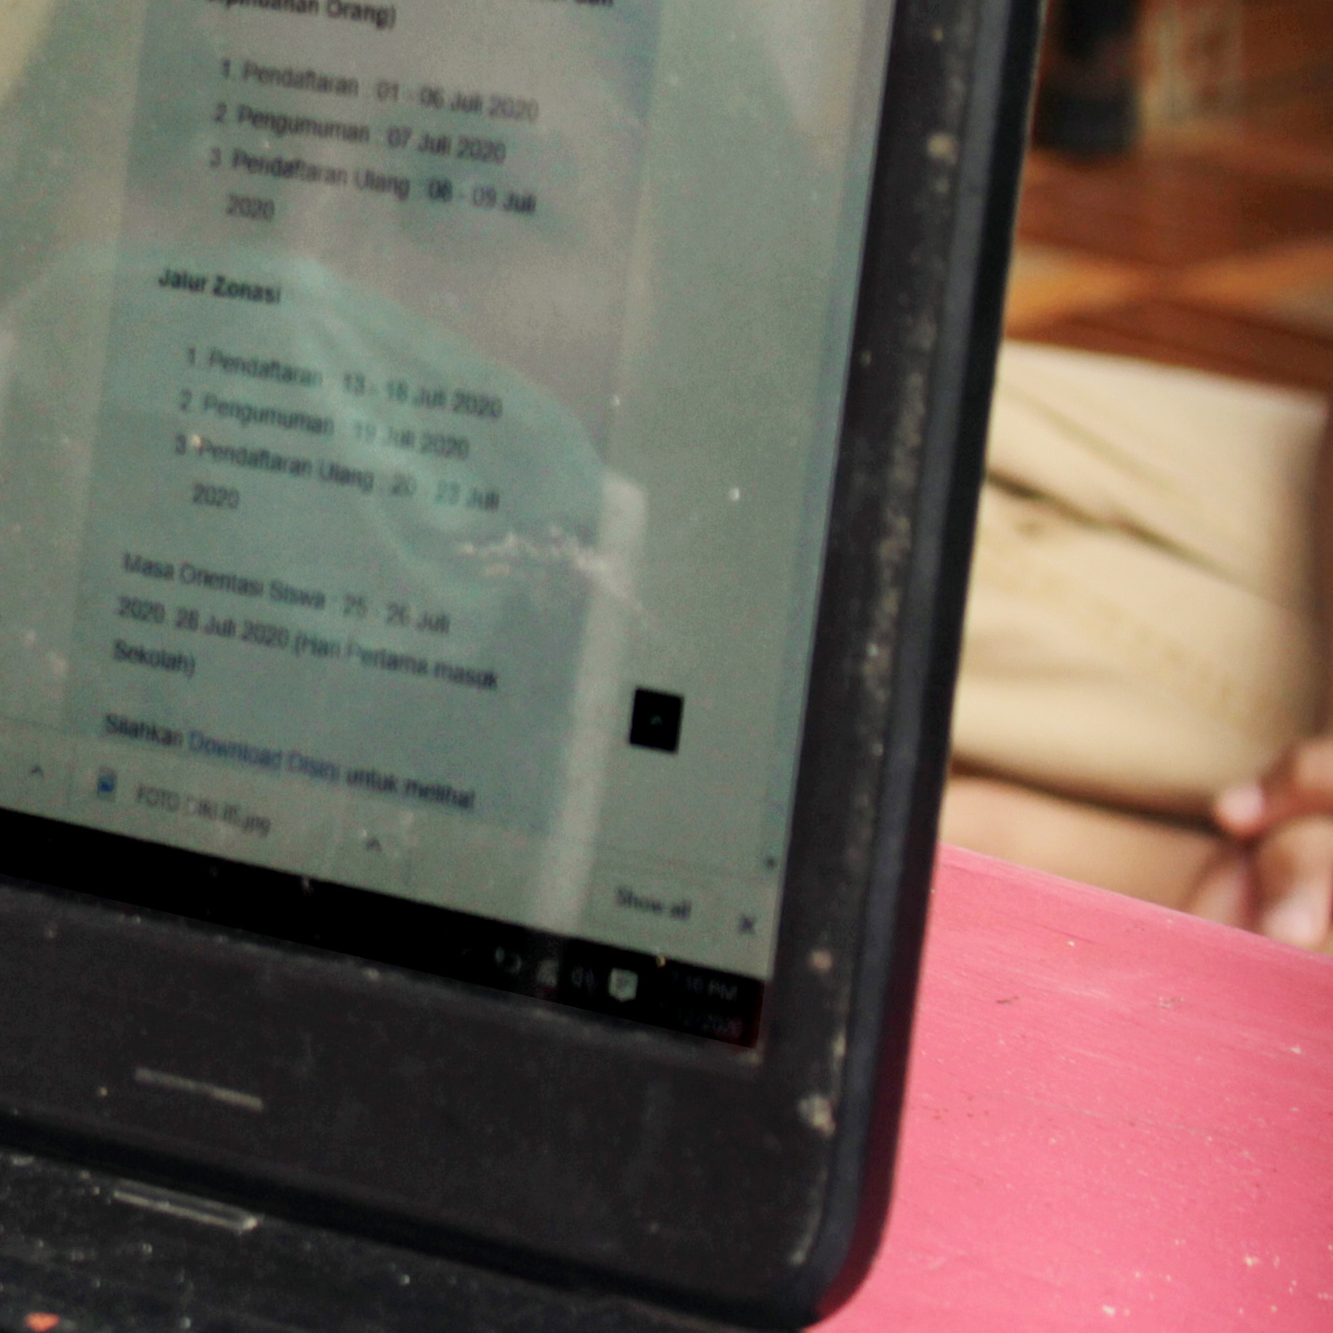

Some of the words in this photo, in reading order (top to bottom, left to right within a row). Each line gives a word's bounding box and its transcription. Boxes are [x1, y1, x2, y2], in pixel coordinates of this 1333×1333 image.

[157, 267, 208, 294] Jalur
[211, 273, 283, 305] Zonasi
[122, 550, 176, 582] Masa
